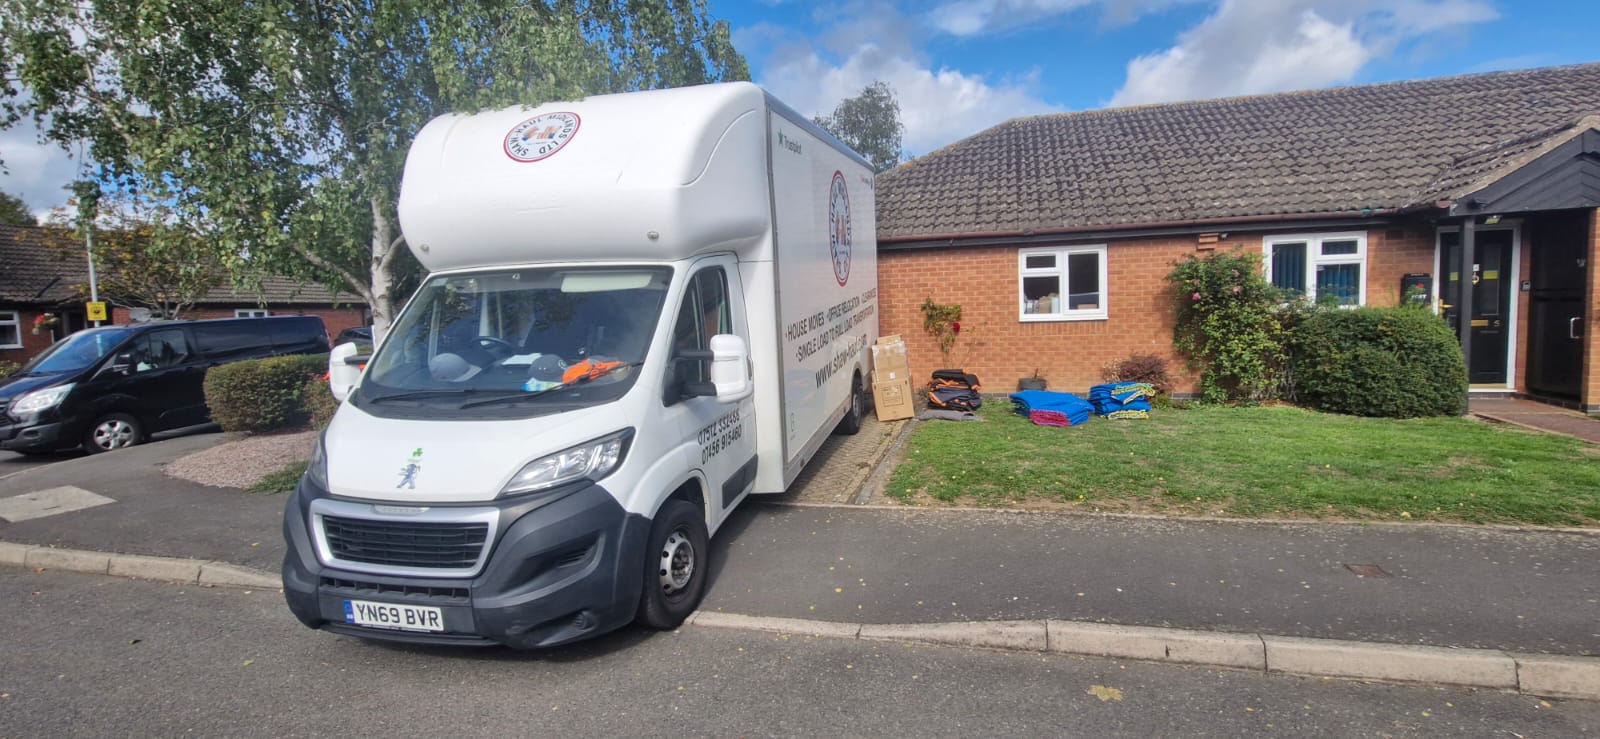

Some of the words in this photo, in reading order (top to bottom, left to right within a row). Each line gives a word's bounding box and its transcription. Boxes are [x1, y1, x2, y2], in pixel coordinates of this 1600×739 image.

[539, 140, 559, 154] LTD
[788, 319, 807, 341] HOUSE
[808, 312, 825, 332] MOVES
[797, 338, 816, 362] SINGLE
[817, 331, 829, 351] LOAD
[702, 438, 720, 465] 07456
[356, 603, 400, 624] YN69
[405, 608, 440, 627] BVR
